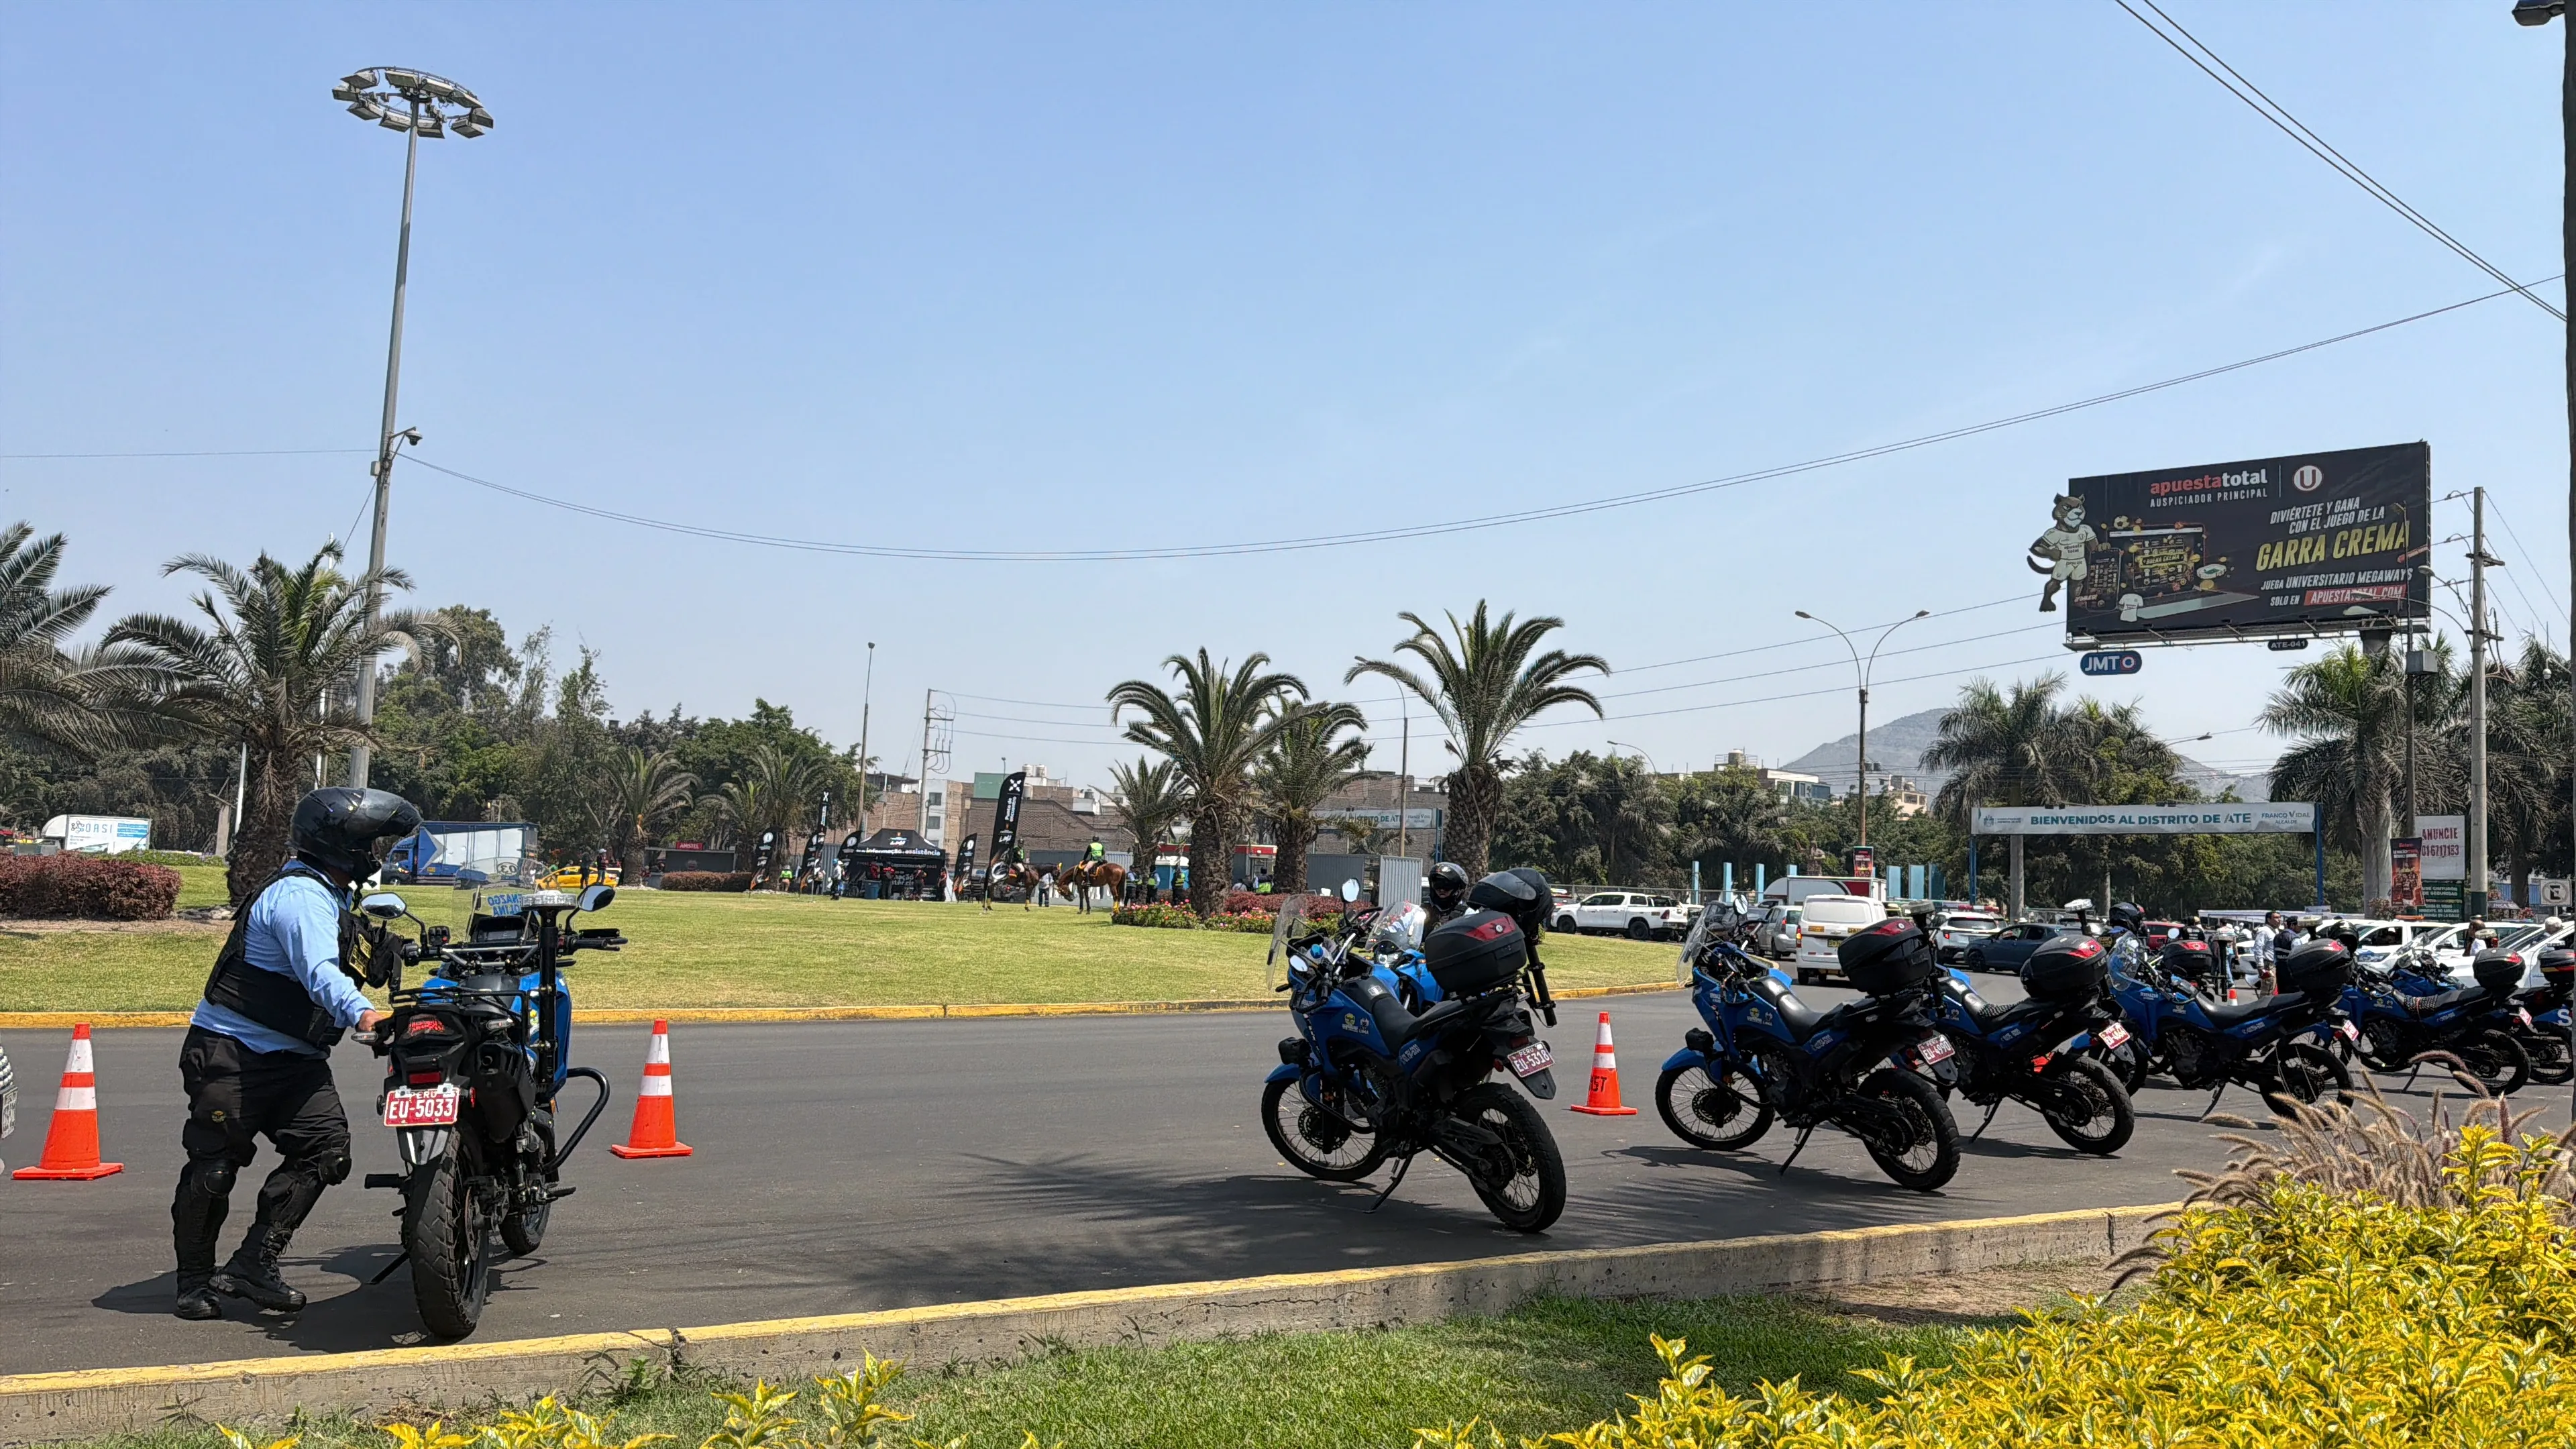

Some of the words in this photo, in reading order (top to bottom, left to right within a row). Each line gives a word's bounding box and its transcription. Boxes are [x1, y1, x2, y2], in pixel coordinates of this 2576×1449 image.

[2150, 469, 2267, 496] apuestatotal
[2150, 493, 2212, 508] AUSPICIADOR
[2217, 488, 2267, 502] PRINCIPAL
[2270, 503, 2324, 525] DIVIÉRTETE
[2326, 502, 2334, 515] Y
[2334, 496, 2361, 512] GANA
[2289, 519, 2308, 535] CON
[2310, 517, 2322, 531] EL
[2323, 511, 2355, 529] JUEGO
[2357, 508, 2371, 523] DE
[2372, 506, 2385, 521] LA
[2256, 534, 2326, 572] GARRA
[2332, 520, 2410, 559] CREMA
[2261, 579, 2284, 591] JUEGA
[2286, 572, 2354, 589] UNIVERSITARIO
[2357, 568, 2414, 584] MEGAWAYS
[2270, 596, 2288, 606] SOLO
[2290, 595, 2300, 605] EN
[2031, 815, 2115, 825] BIENVENIDOS
[2118, 815, 2135, 824] AL
[2138, 814, 2199, 825] DISTRITO
[2202, 814, 2221, 824] DE
[2224, 813, 2251, 824] ATE
[2289, 810, 2310, 818] VIDAL
[2422, 827, 2458, 840] ANUNCIE
[1513, 1049, 1550, 1073] EU-5318
[1922, 1040, 1951, 1060] EU-4990
[388, 1098, 453, 1120] EU-5033
